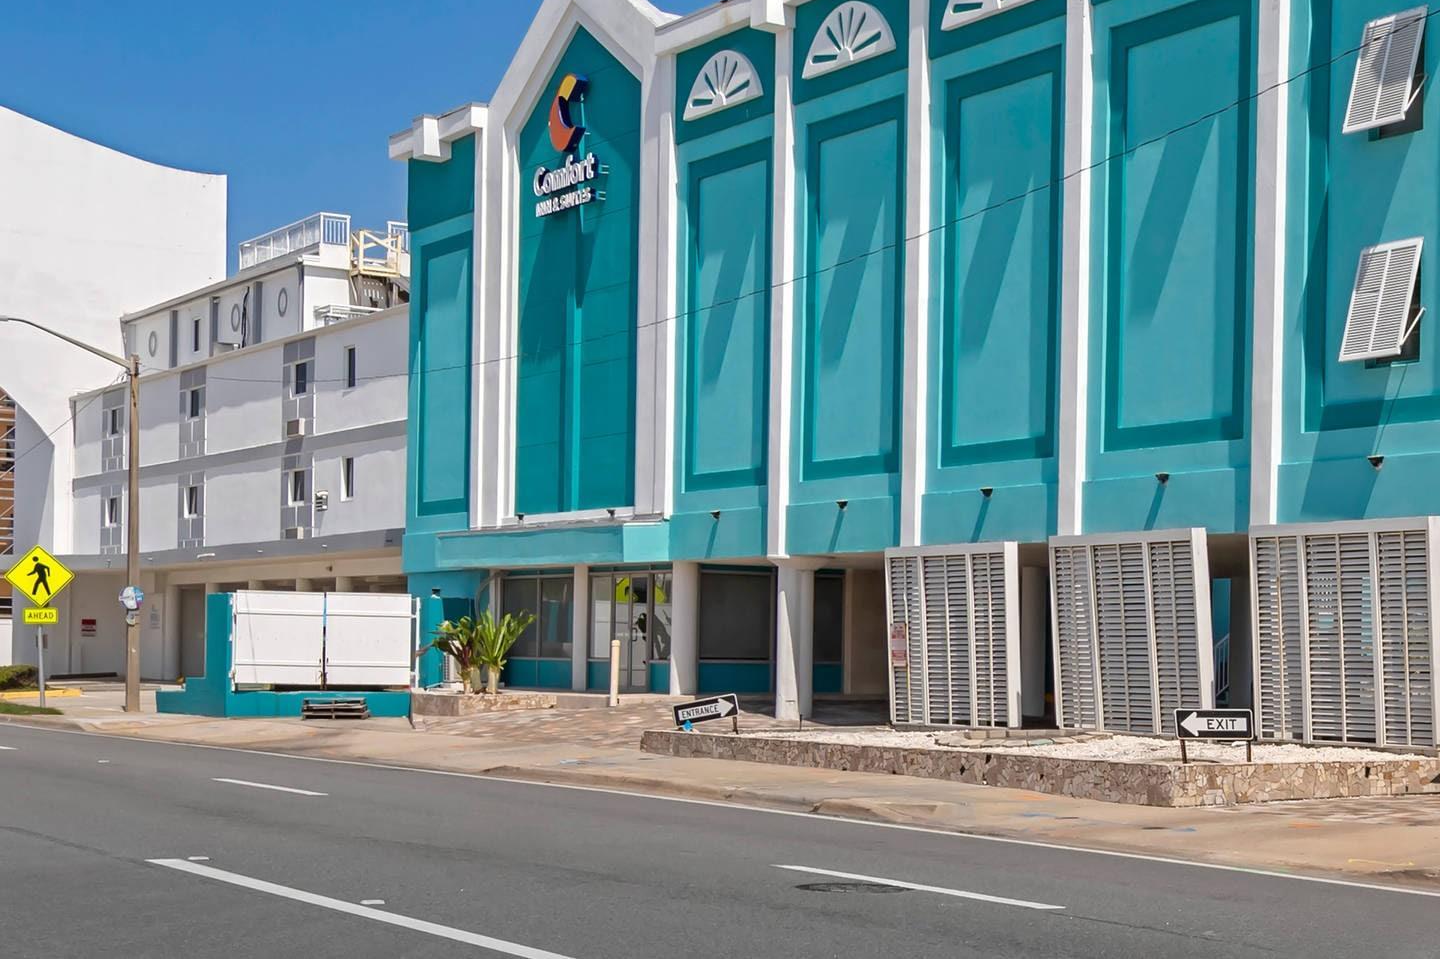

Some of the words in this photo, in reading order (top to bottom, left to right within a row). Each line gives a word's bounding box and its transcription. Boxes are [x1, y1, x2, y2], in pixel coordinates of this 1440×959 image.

[533, 152, 595, 197] Comfort
[27, 611, 55, 620] AHEAD
[681, 704, 719, 719] ENTRANCE
[1206, 718, 1237, 730] EXIT
